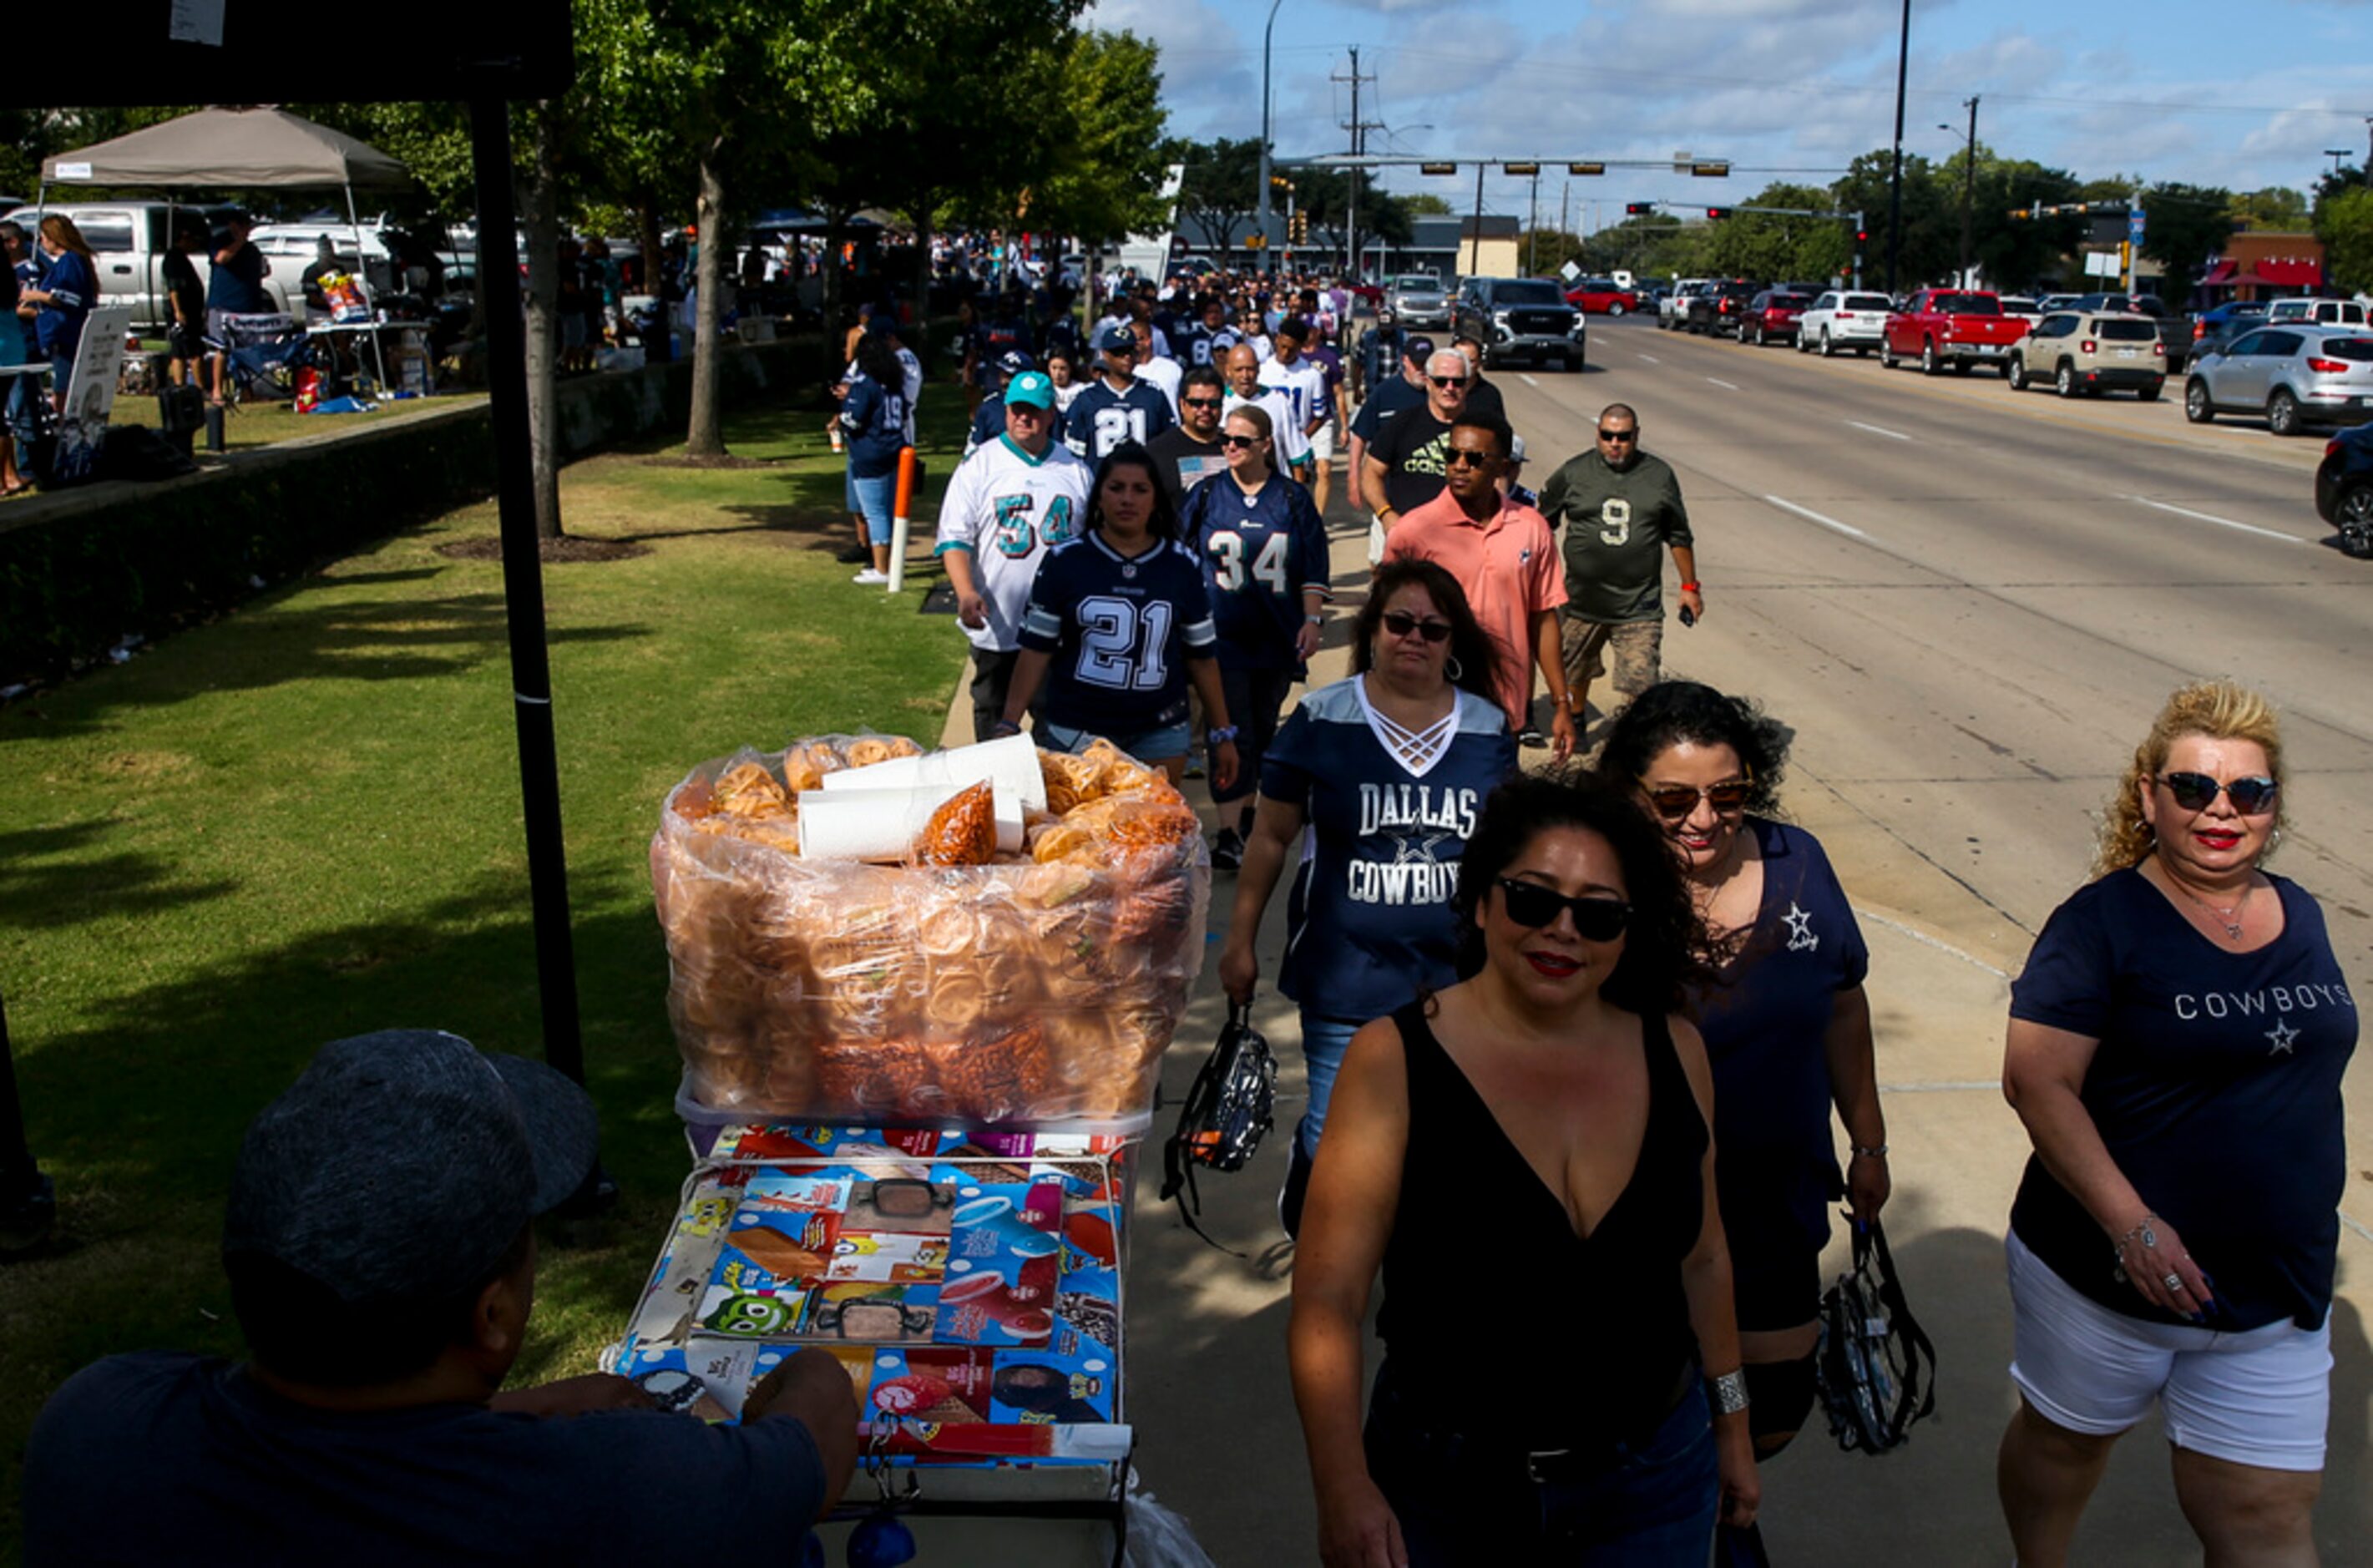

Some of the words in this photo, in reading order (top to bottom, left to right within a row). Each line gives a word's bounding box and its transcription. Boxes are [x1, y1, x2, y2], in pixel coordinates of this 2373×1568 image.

[1094, 408, 1146, 458] 21
[993, 493, 1073, 559] 54
[1600, 498, 1631, 546] 9
[1207, 529, 1291, 594] 34
[1074, 595, 1172, 690] 21
[1359, 782, 1478, 840] DALLAS
[1348, 857, 1462, 906] COWBOY
[2174, 984, 2353, 1019] COWBOYS
